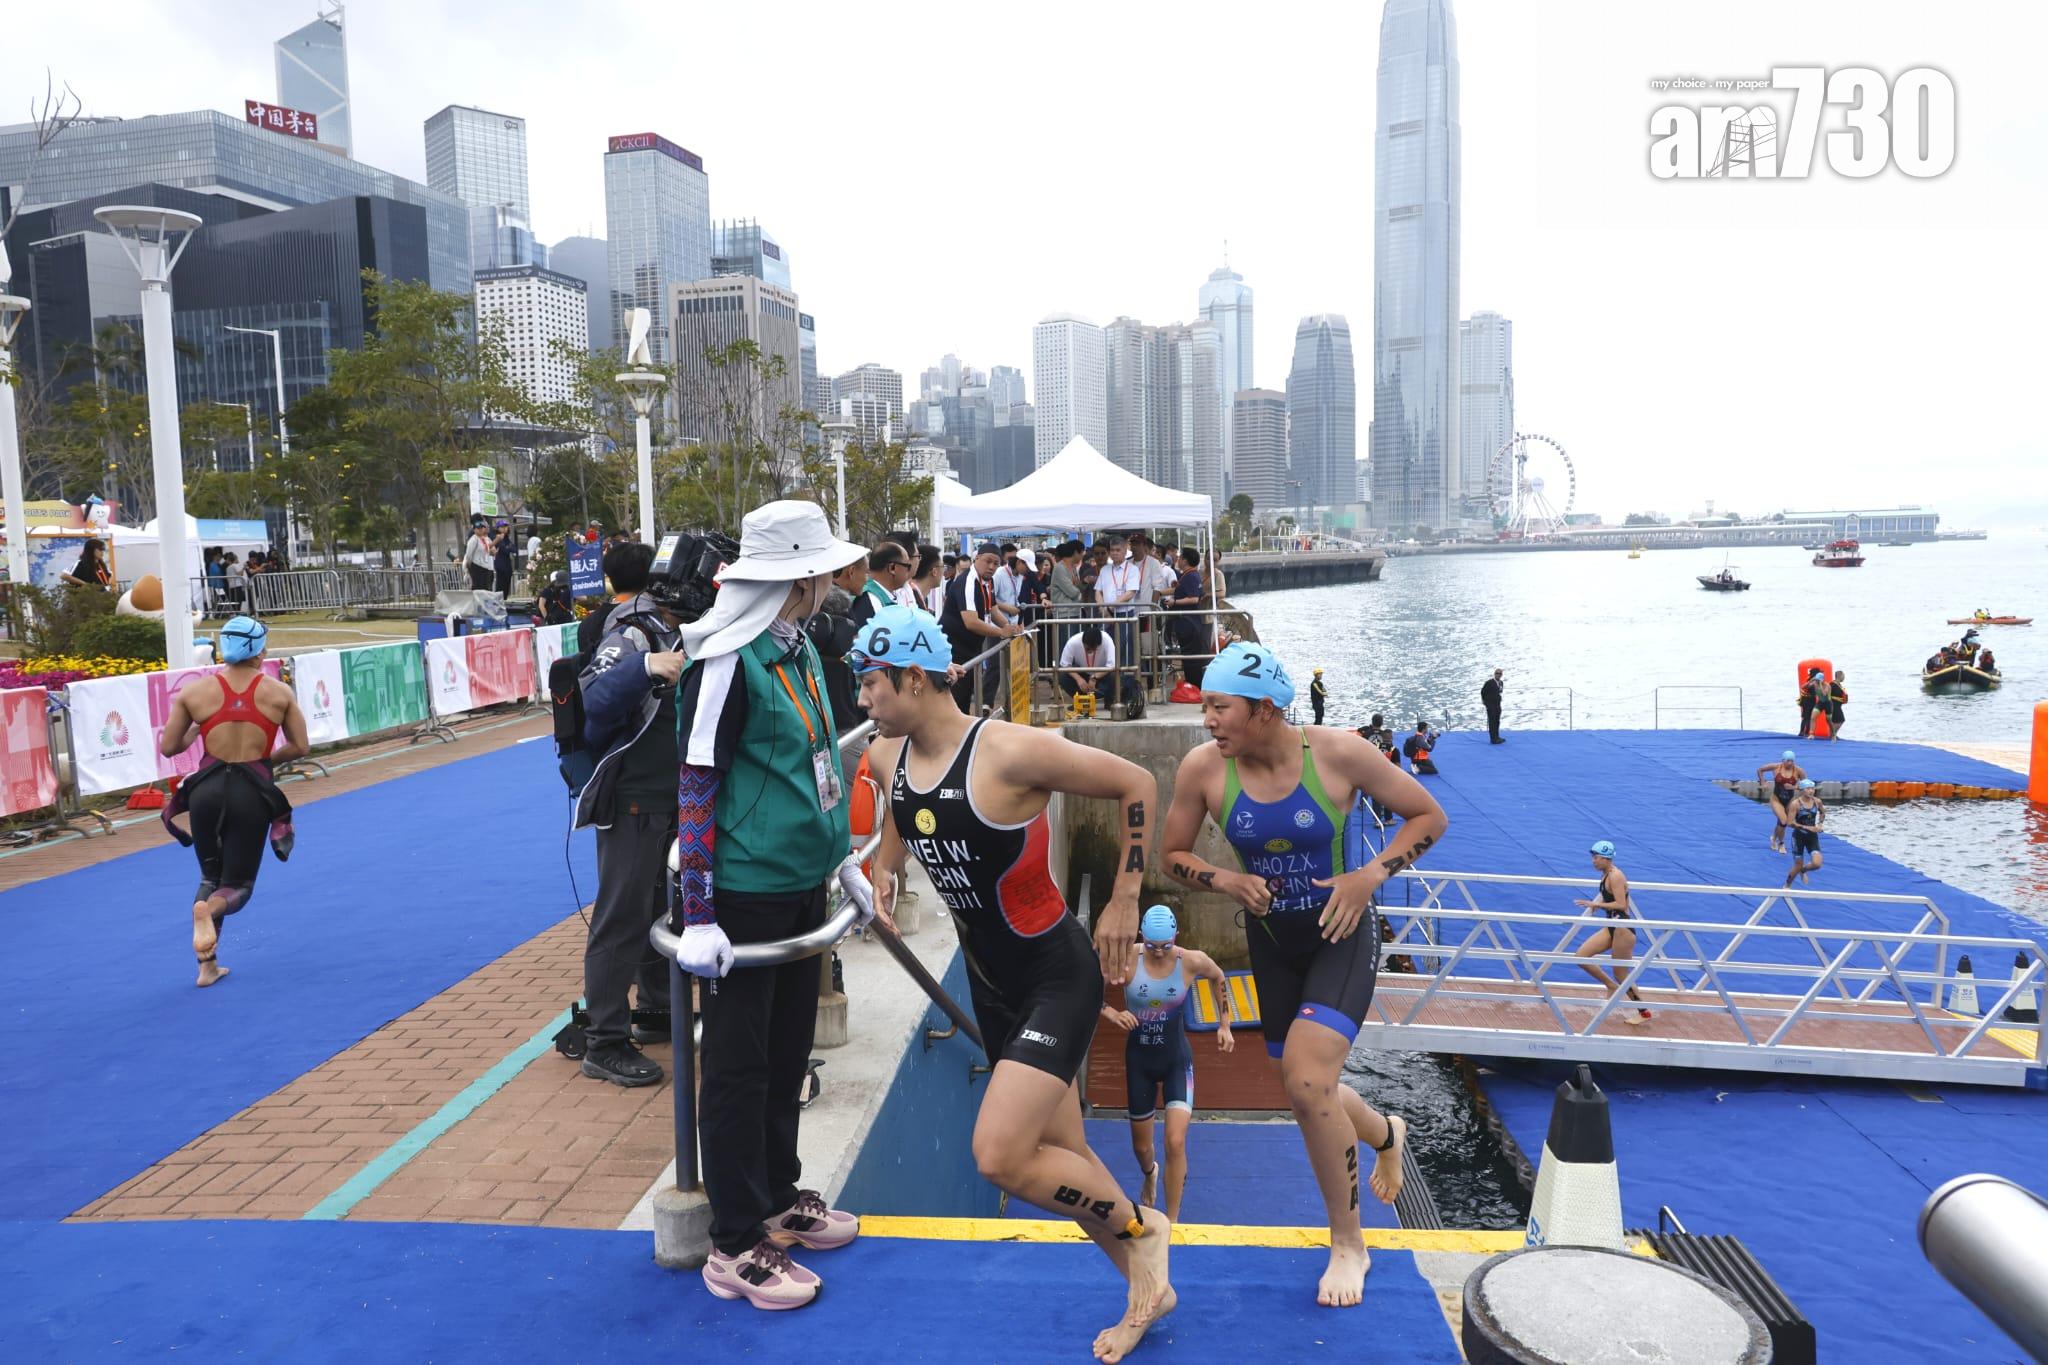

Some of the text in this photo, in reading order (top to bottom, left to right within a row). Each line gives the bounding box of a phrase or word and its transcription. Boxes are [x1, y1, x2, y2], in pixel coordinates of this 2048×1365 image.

[248, 102, 315, 135] 中国茅台
[902, 837, 981, 864] WEI W.
[1251, 851, 1318, 875] HAO Z.X.
[927, 866, 972, 889] CHN
[1282, 875, 1310, 895] HN
[1142, 1023, 1164, 1033] CHN
